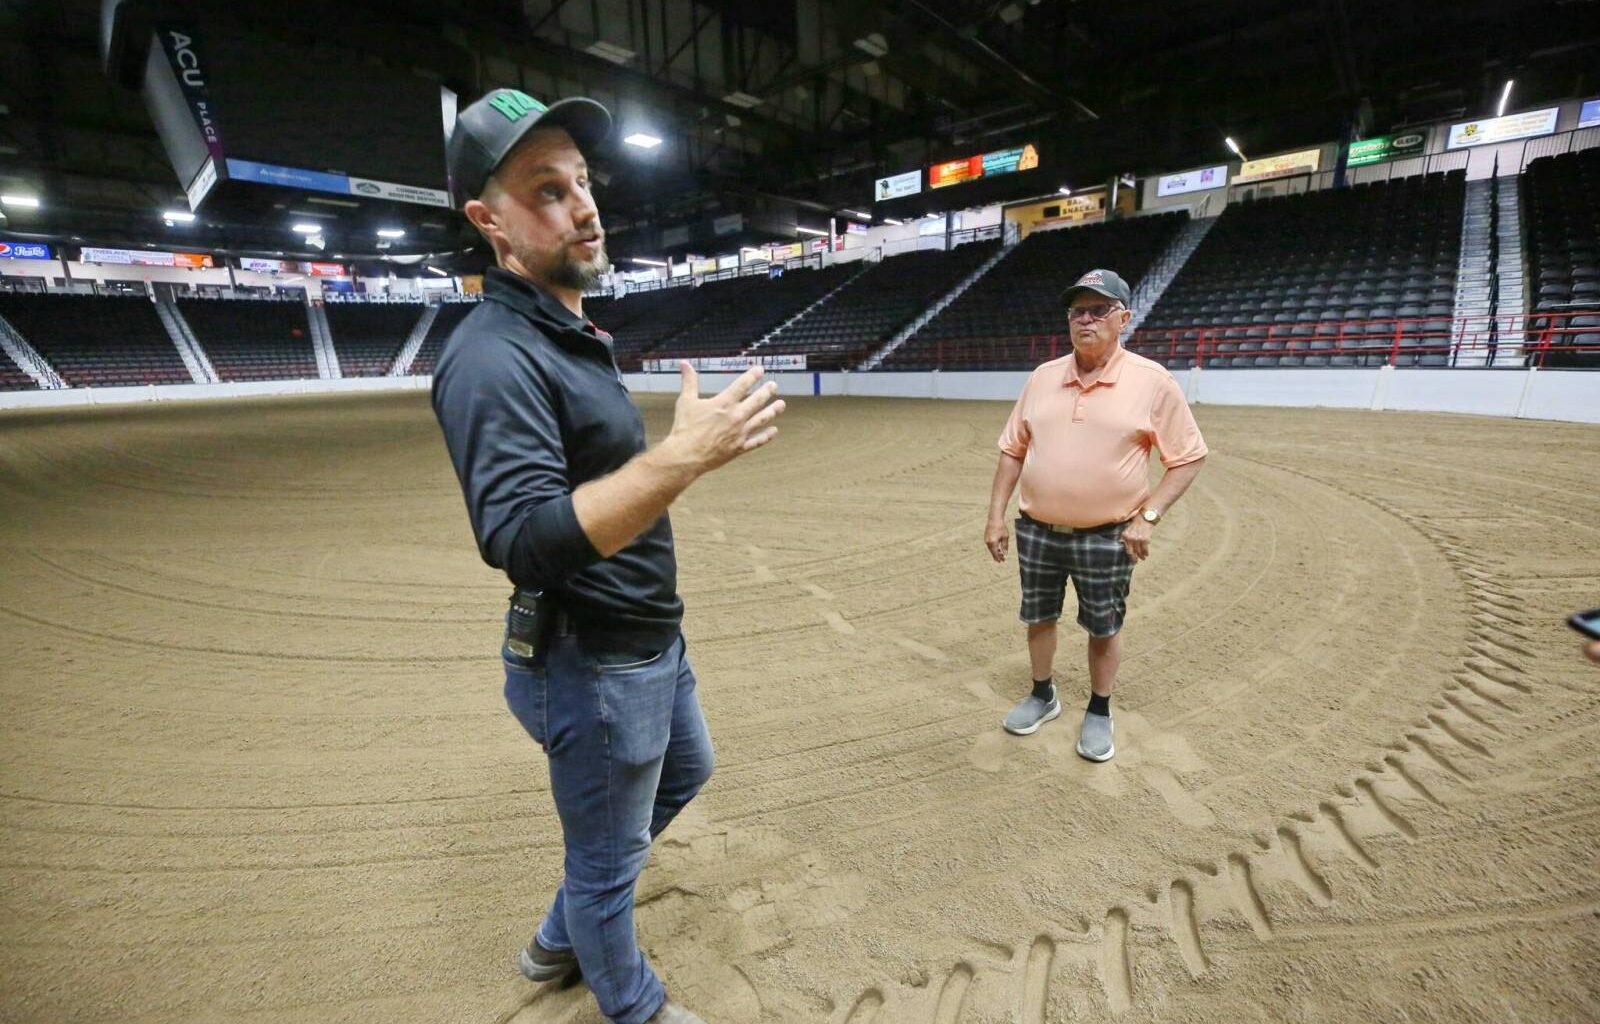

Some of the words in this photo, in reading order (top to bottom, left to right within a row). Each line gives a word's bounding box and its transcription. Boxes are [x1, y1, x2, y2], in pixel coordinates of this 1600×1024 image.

[169, 30, 204, 86] ACU
[196, 101, 217, 143] PLACE
[416, 195, 445, 205] SERVICES
